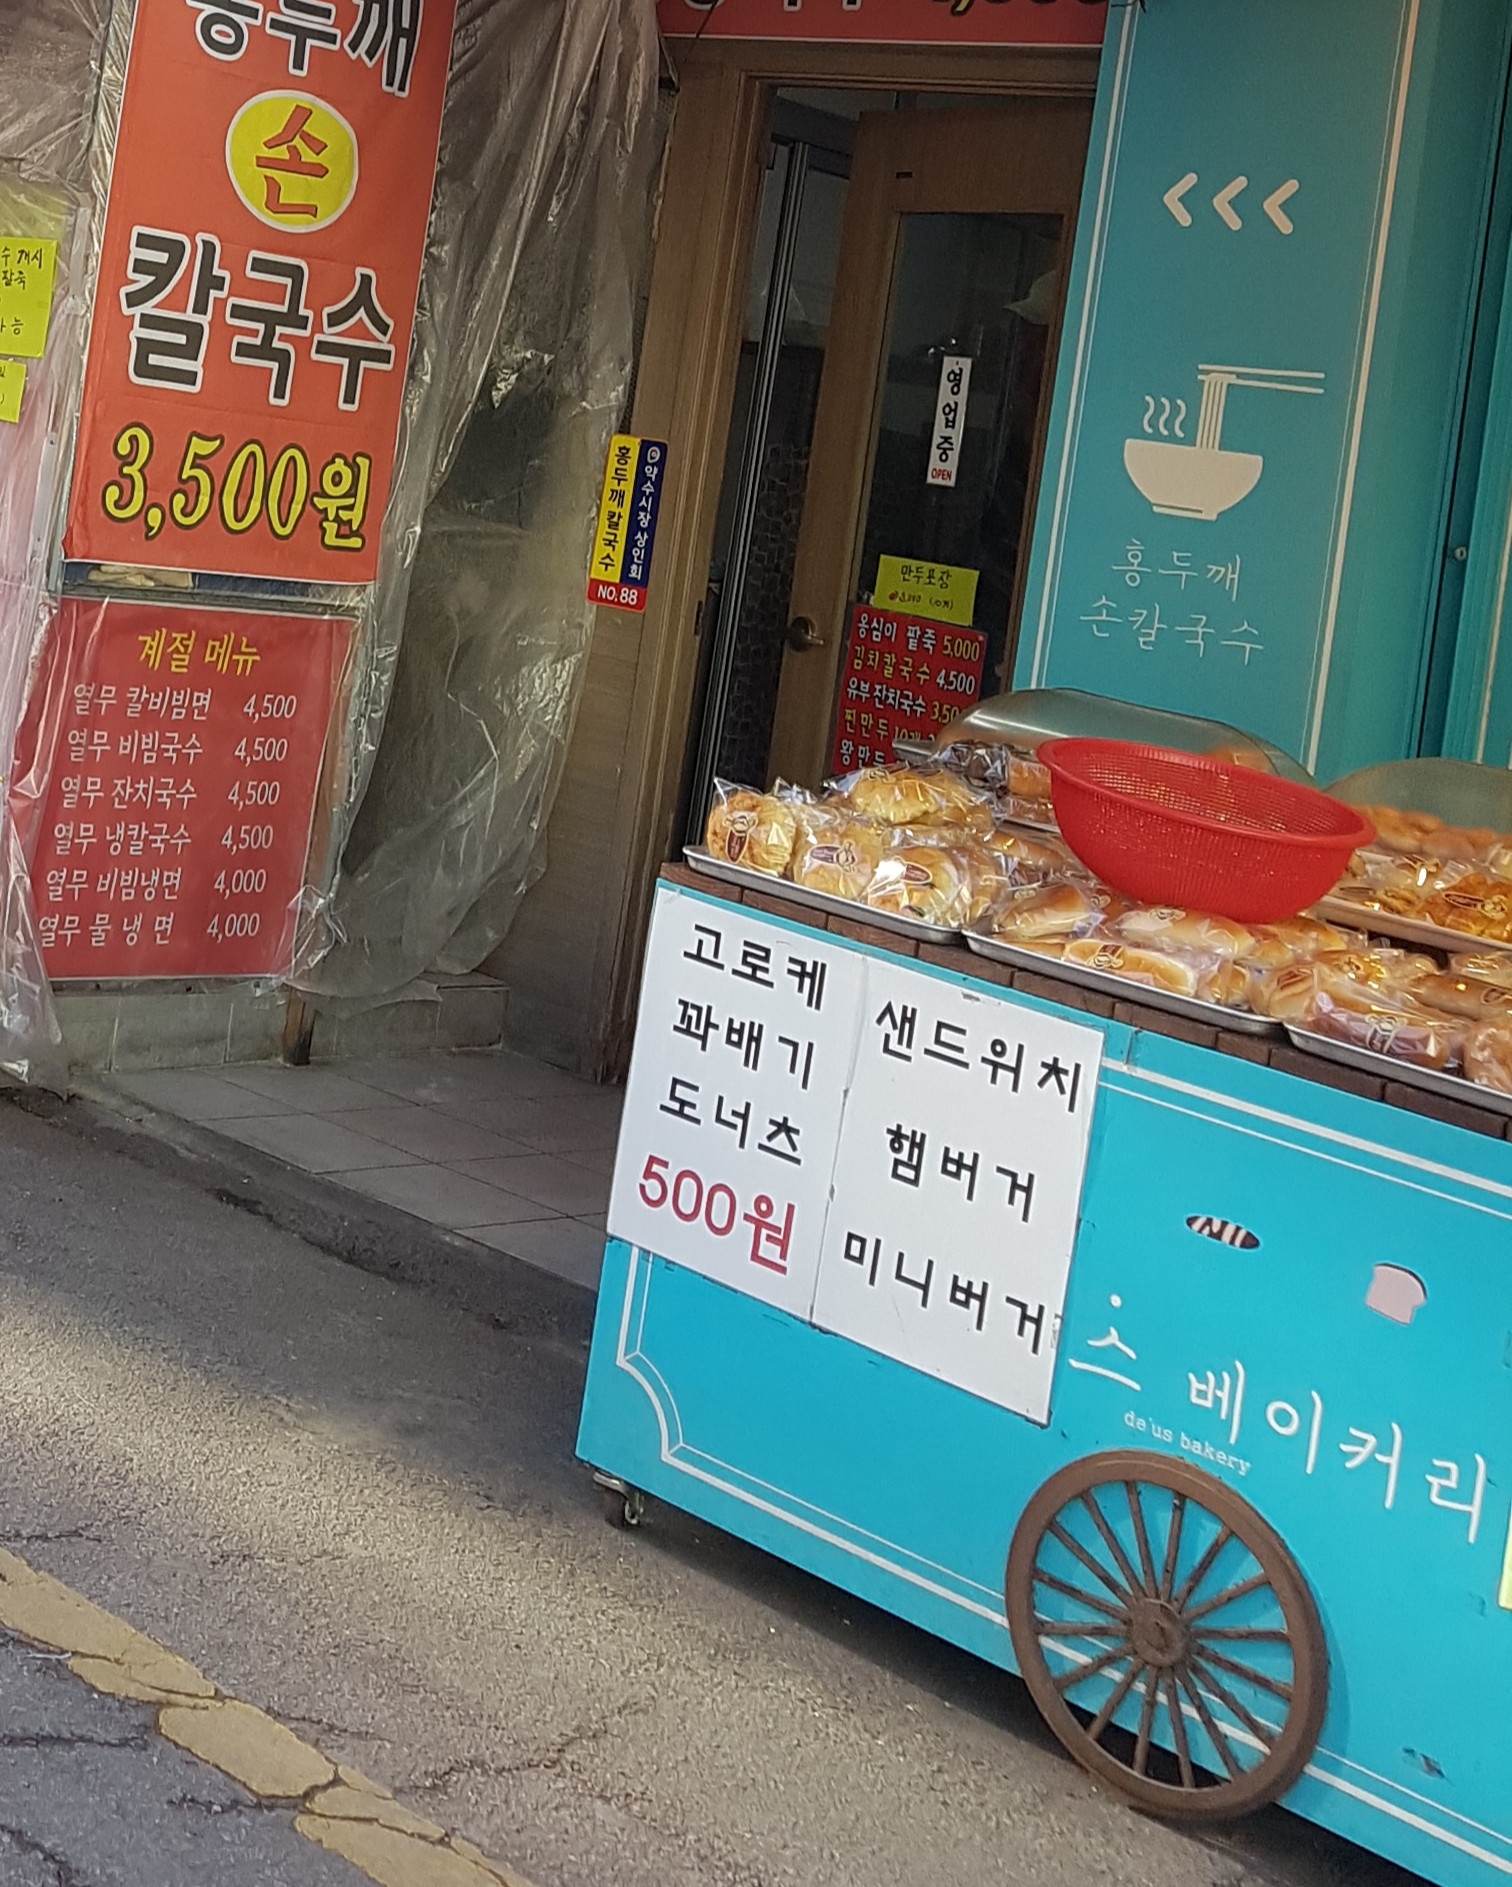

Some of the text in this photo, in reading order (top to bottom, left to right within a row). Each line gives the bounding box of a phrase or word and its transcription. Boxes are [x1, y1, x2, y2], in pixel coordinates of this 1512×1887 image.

[255, 103, 329, 218] 손
[120, 225, 394, 411] 칼국수
[103, 422, 371, 552] 3,500원
[931, 468, 953, 482] OPEN
[1111, 539, 1242, 602] 홍두깨
[137, 627, 261, 676] 계절 메뉴
[858, 613, 980, 662] 옹심이 팥죽 5,000
[1079, 595, 1264, 666] 손칼국수
[73, 682, 297, 724] 열무 칼비빔면 4,500
[847, 677, 870, 703] 유부
[873, 684, 927, 718] 잔치국수
[936, 669, 976, 696] 4,500
[67, 729, 288, 767] 열무 비빔국수 4,500
[61, 775, 281, 811] 열무 잔치국수 4,500
[54, 822, 274, 858] 열무 냉칼국수 4,500
[46, 868, 266, 903] 열무 비빔냉면 4,000
[39, 914, 81, 948] 열무
[207, 913, 260, 943] 4,000
[683, 923, 827, 1011] 고로케
[672, 997, 814, 1090] 꽈배기
[876, 1000, 1082, 1113] 샌드위치
[659, 1076, 802, 1165] 도너츠
[887, 1123, 1036, 1223] 햄버거
[638, 1154, 795, 1276] 500원
[844, 1231, 1047, 1356] 미니버거
[1180, 1431, 1251, 1476] bakery
[1188, 1360, 1486, 1545] 베이커리
